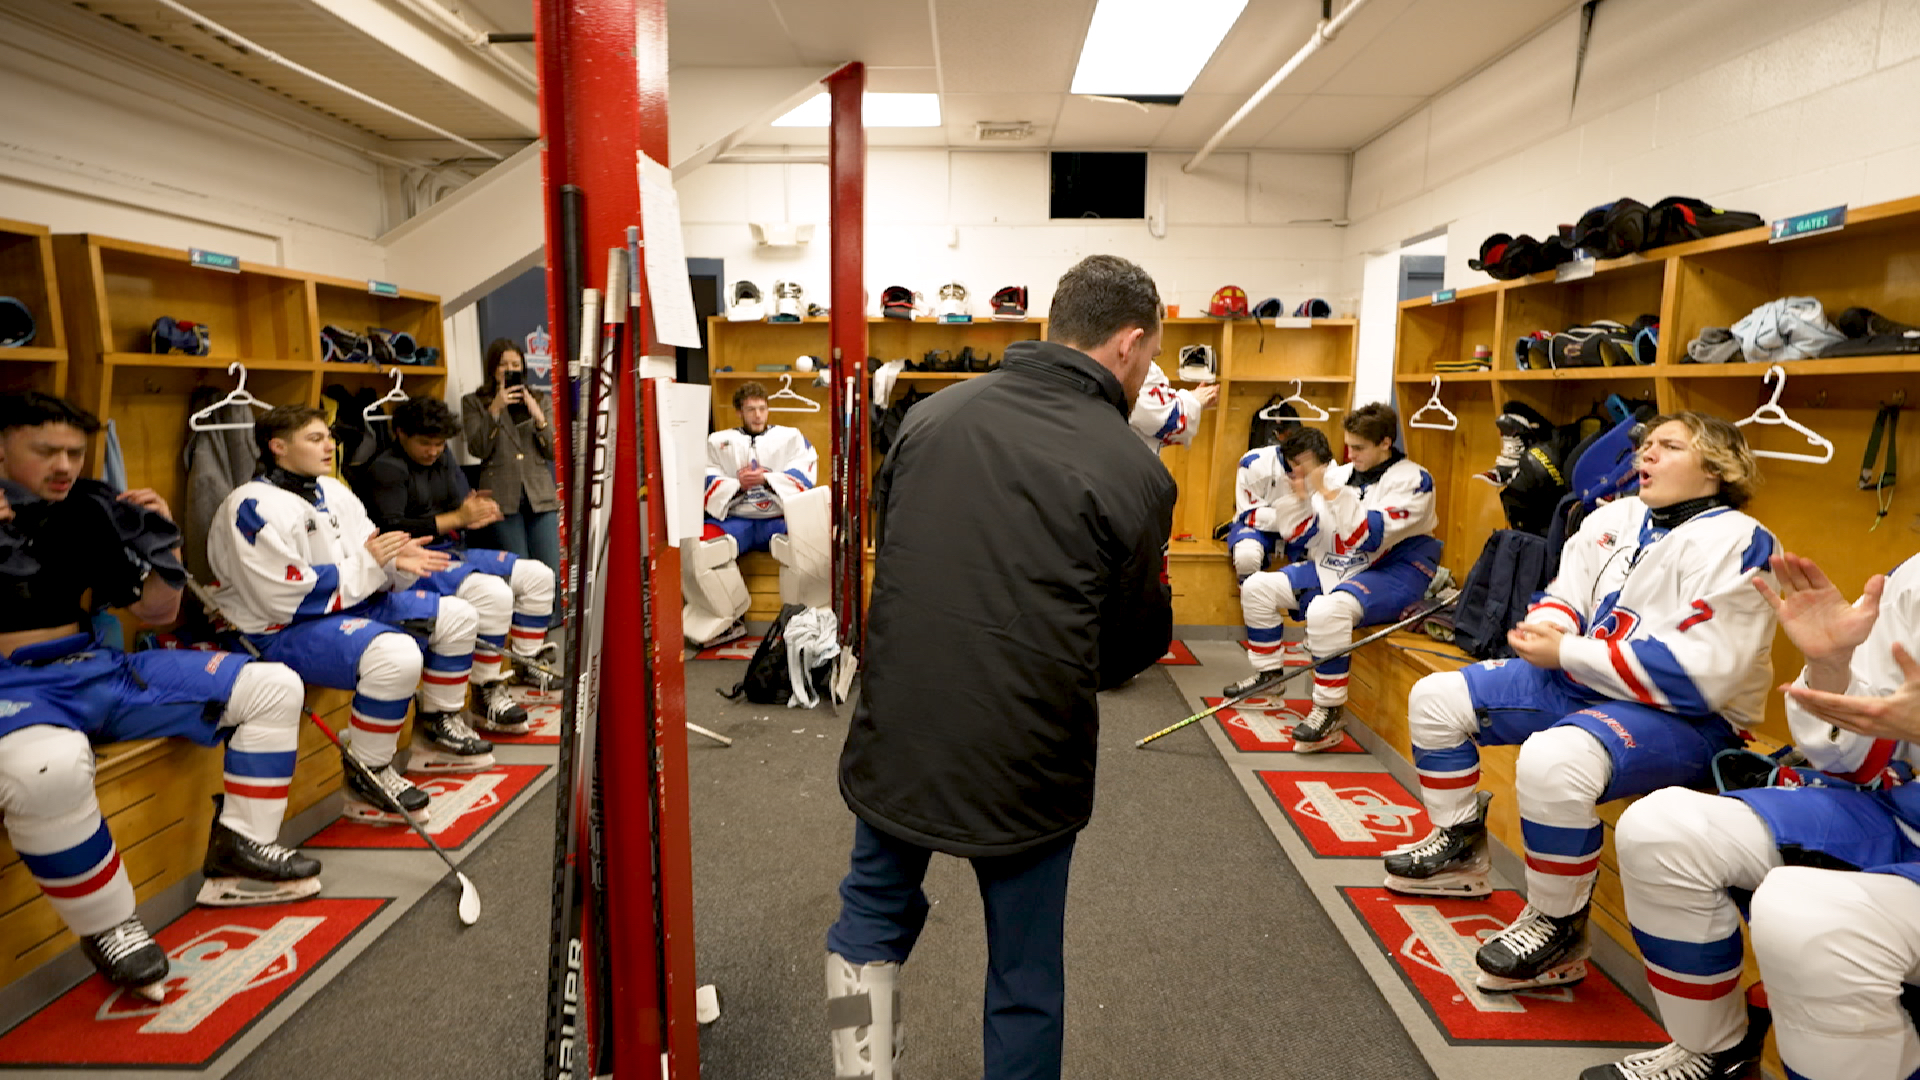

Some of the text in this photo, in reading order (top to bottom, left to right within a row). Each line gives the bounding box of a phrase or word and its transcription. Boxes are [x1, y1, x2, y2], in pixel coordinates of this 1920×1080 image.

[1775, 215, 1828, 238] 7 GATES
[591, 350, 614, 509] VAPOR
[1677, 599, 1715, 632] 7
[587, 651, 600, 720] VAPOR
